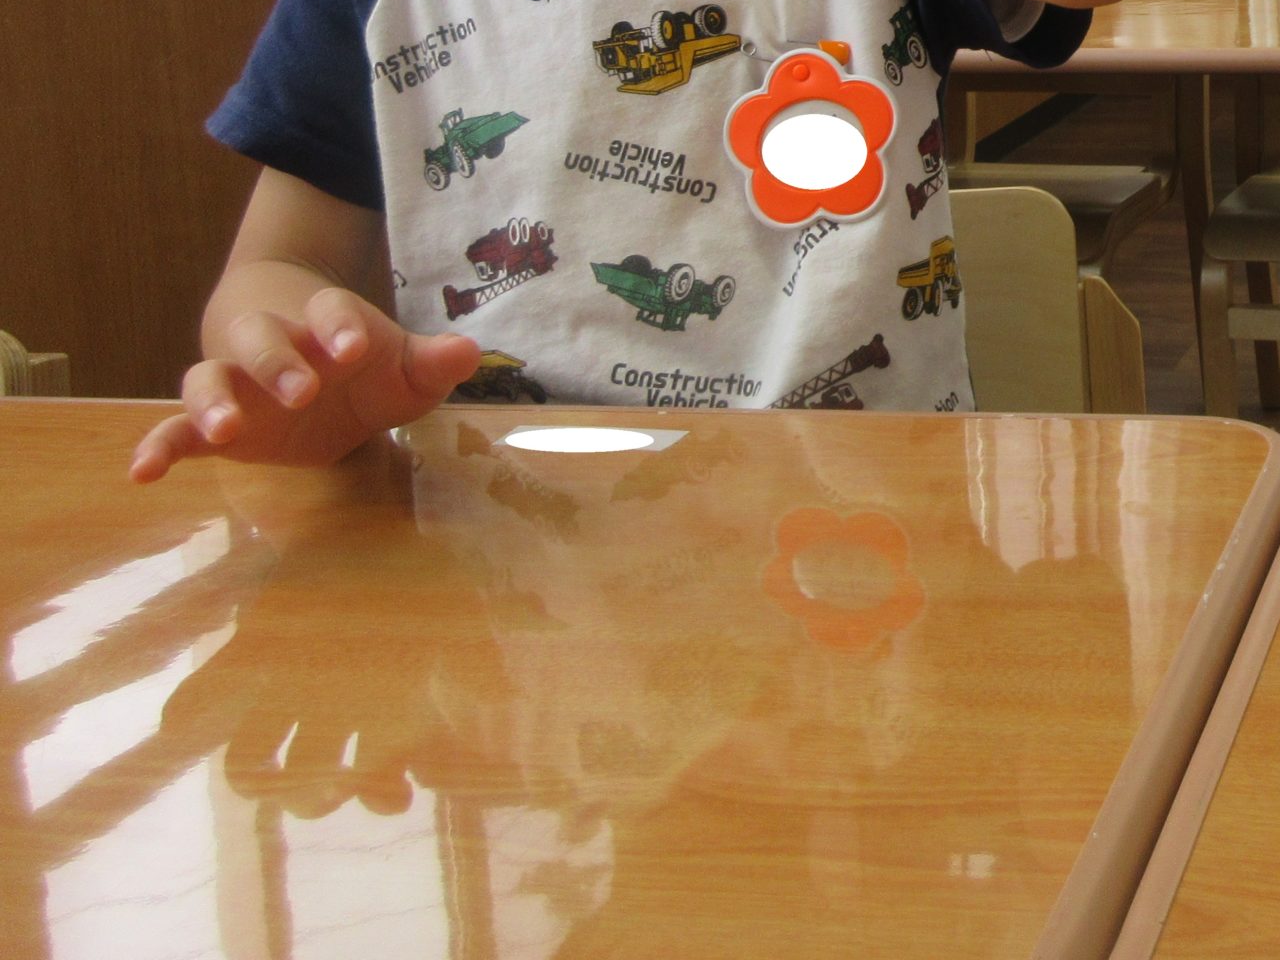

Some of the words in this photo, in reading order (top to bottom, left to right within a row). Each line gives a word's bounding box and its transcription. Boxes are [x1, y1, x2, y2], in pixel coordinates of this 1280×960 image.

[609, 140, 687, 177] Vehicle
[564, 151, 718, 204] Construction
[610, 362, 763, 398] Construction
